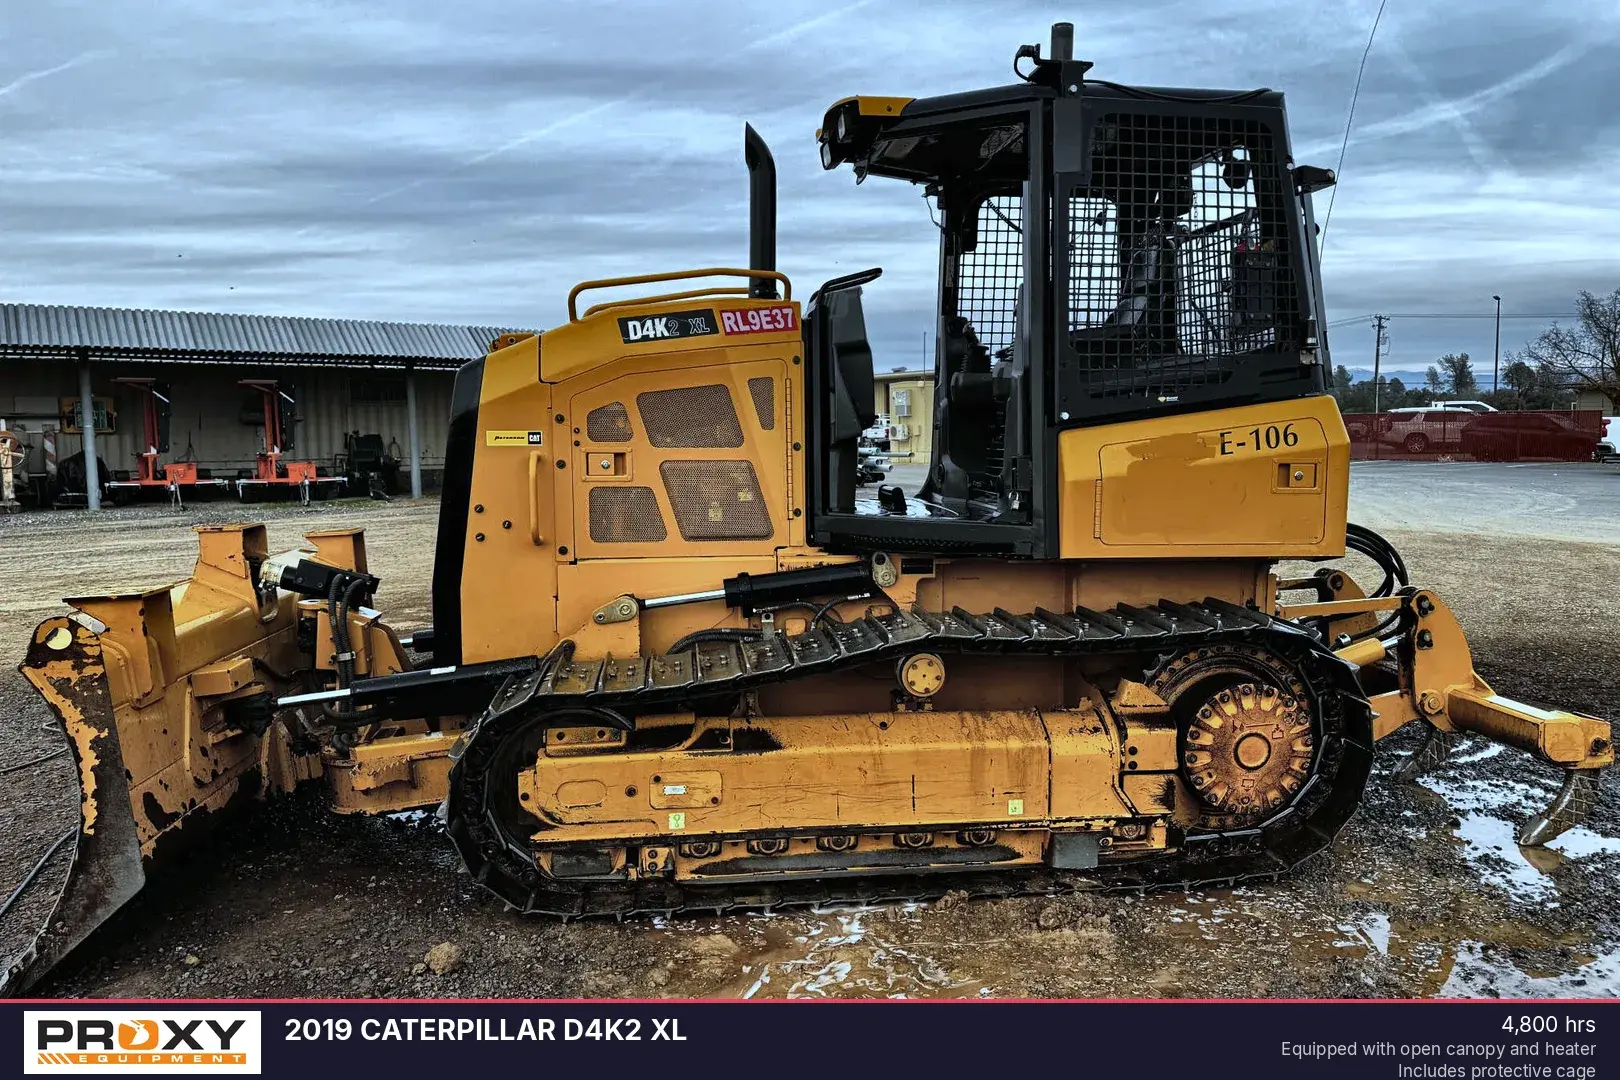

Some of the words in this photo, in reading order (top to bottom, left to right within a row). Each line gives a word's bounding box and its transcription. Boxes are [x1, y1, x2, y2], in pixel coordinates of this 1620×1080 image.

[627, 316, 680, 341] D4K2
[688, 317, 710, 334] XL
[722, 308, 793, 333] RL9E37
[529, 434, 541, 442] CAT
[1219, 423, 1299, 456] E-106
